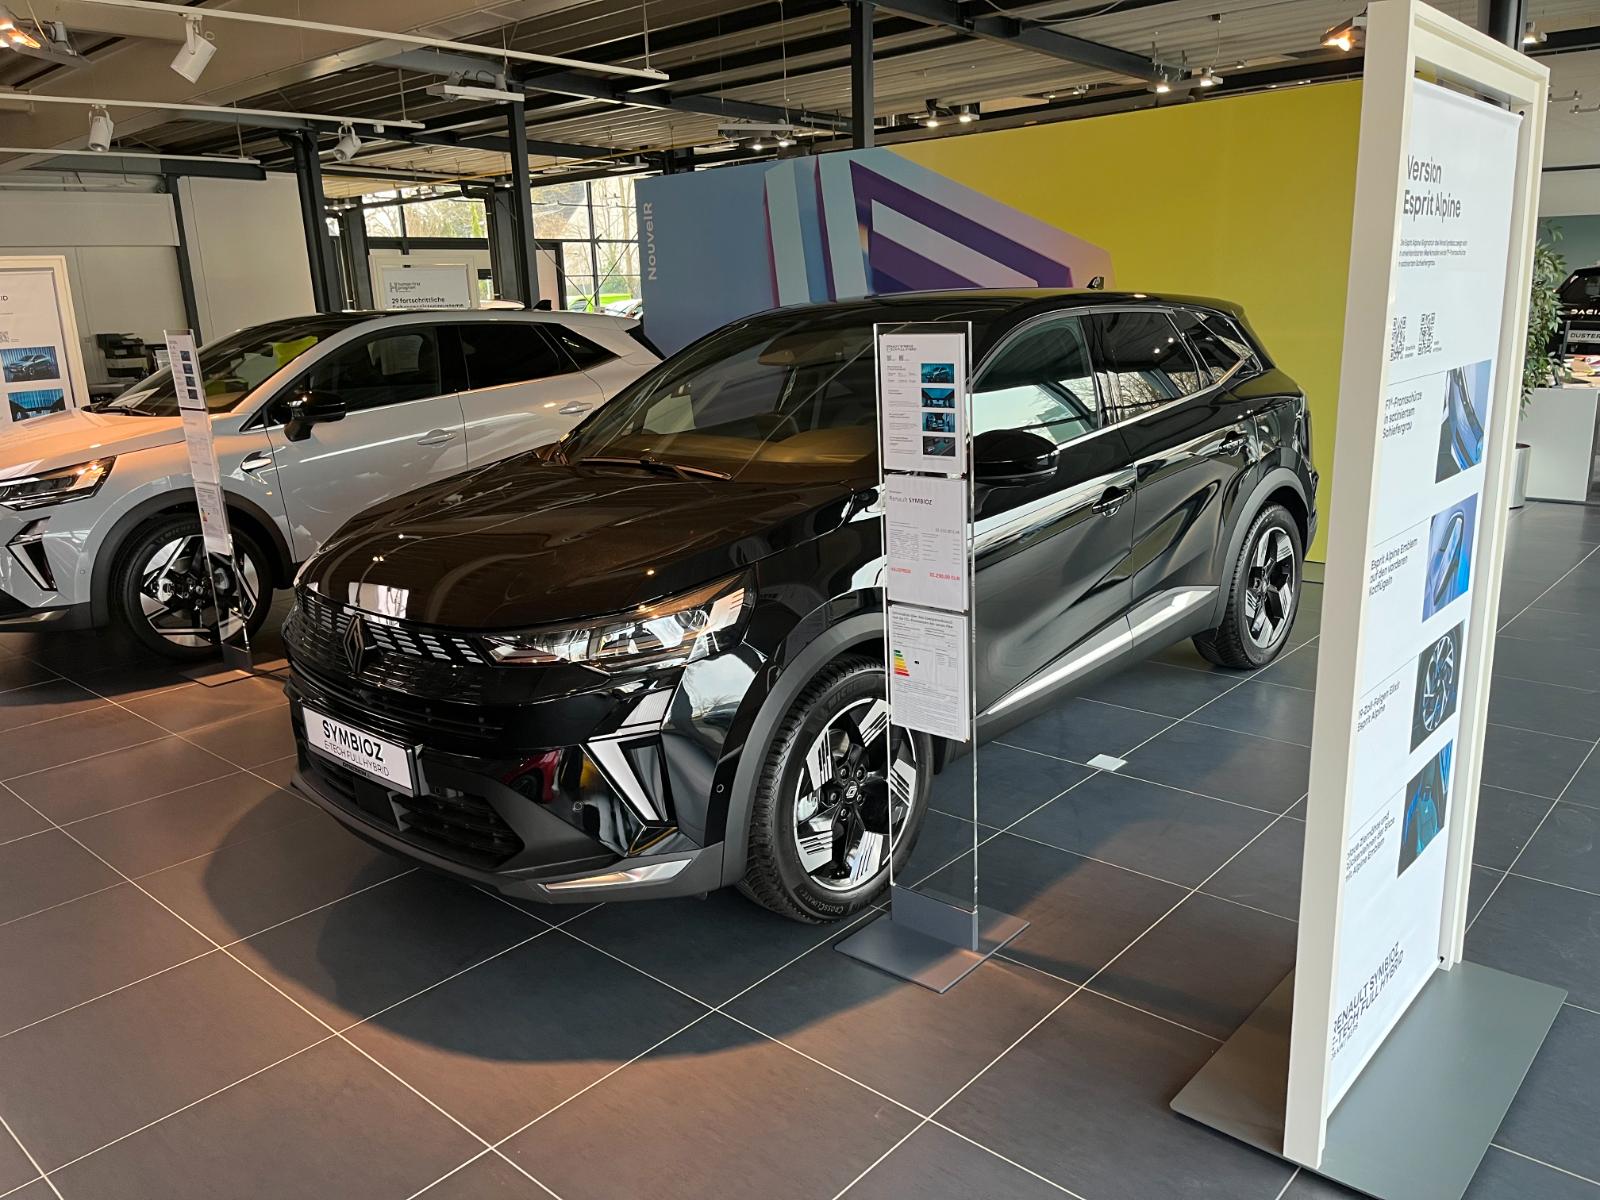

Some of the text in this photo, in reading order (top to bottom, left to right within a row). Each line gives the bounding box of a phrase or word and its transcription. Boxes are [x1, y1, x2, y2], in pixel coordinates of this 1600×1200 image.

[1406, 154, 1442, 184] Version
[1402, 189, 1461, 223] Esprit Alpine
[643, 202, 657, 281] NouvelR
[908, 497, 933, 506] SYMBIOZ
[322, 719, 384, 763] SYMBIOZ
[324, 740, 346, 757] E-TECH
[363, 759, 390, 777] HYBRID
[1360, 984, 1379, 1016] FULL
[1379, 949, 1404, 992] HYBRID
[1369, 941, 1399, 991] SYMBIOZ
